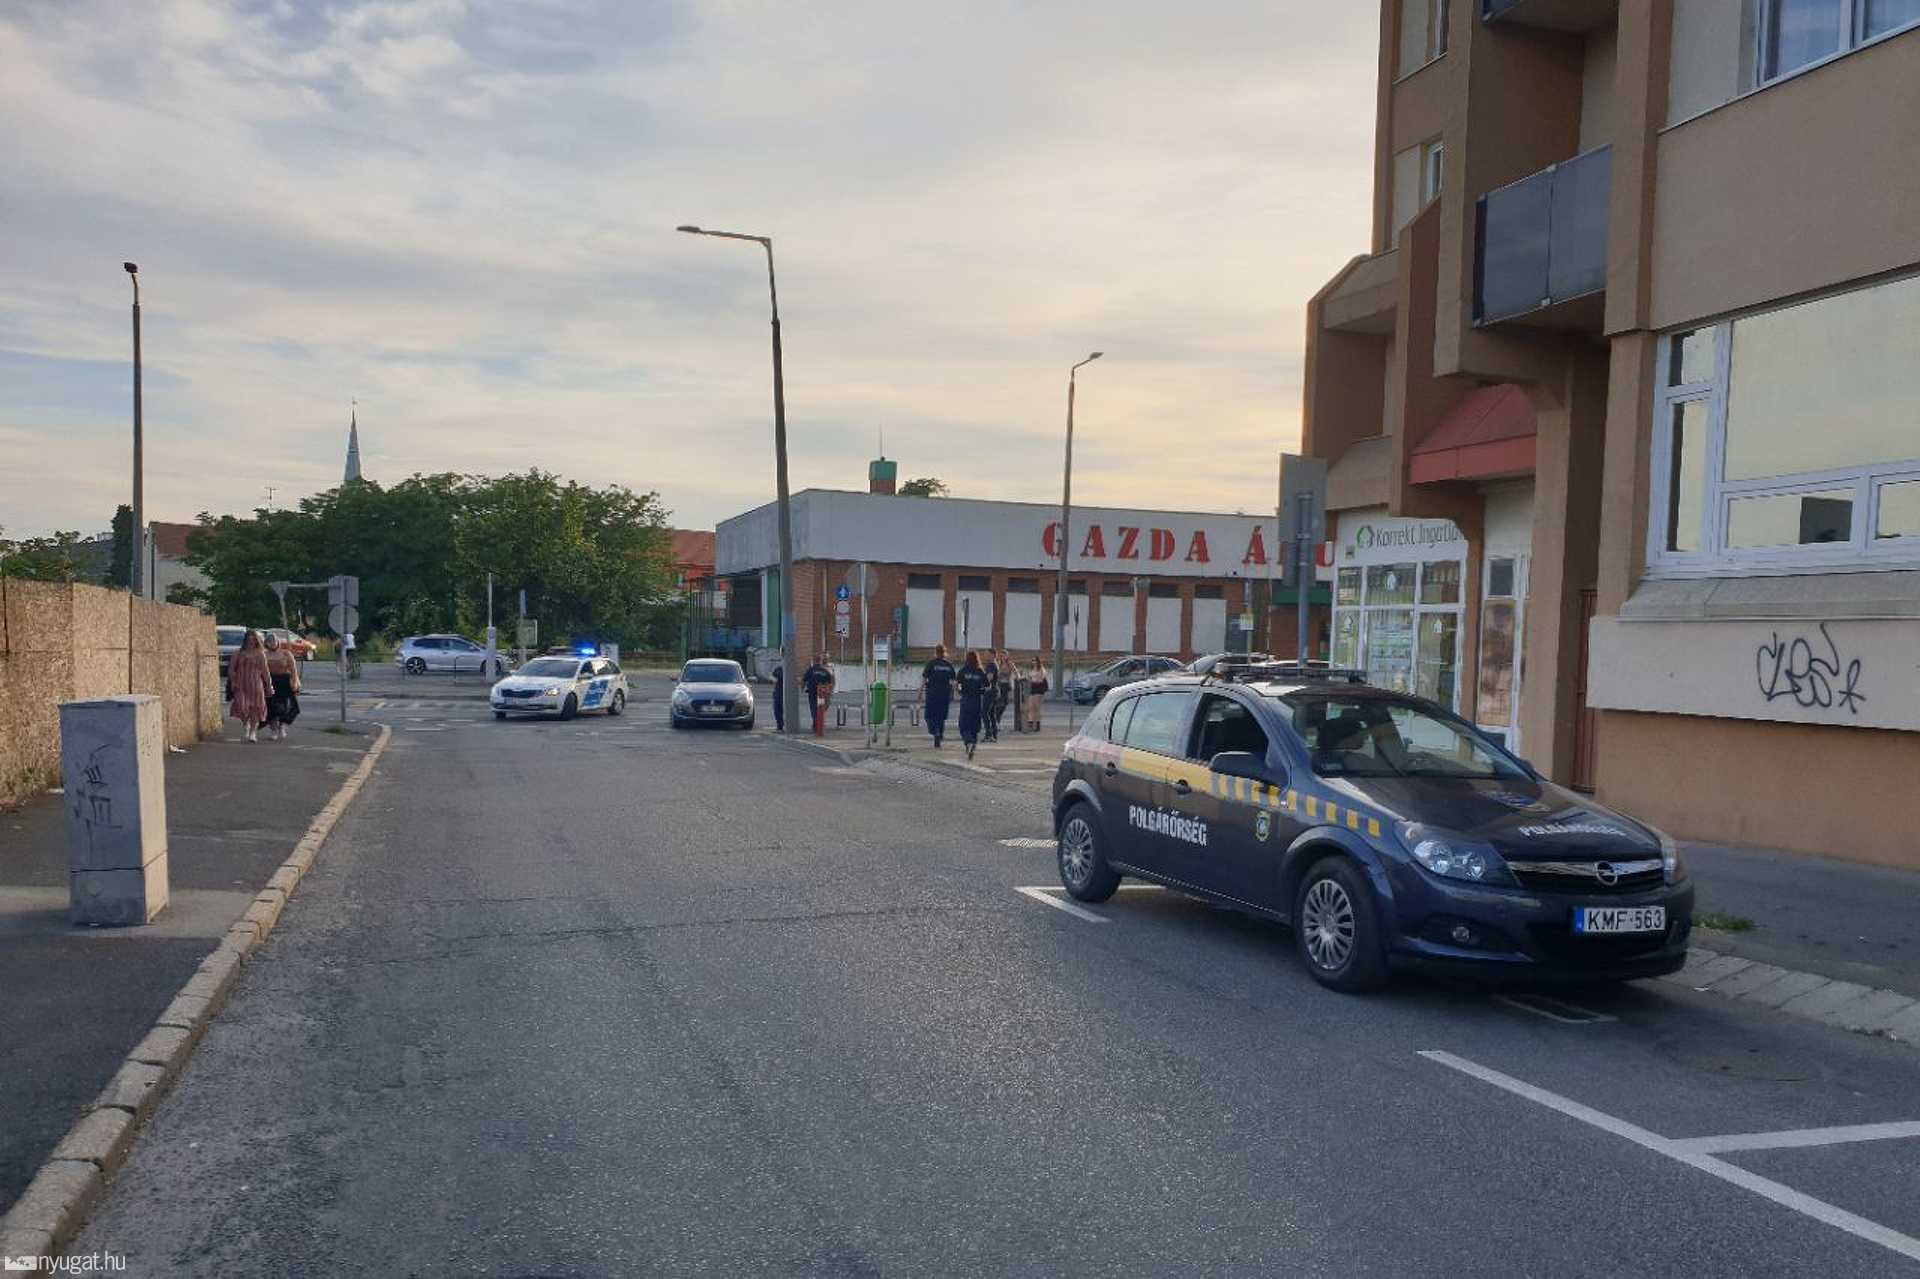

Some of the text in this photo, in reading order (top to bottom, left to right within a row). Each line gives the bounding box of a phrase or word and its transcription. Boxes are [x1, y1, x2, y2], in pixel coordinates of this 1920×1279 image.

[1042, 522, 1335, 567] GAZDA ÁU
[1376, 526, 1416, 547] Korrekt
[1129, 804, 1208, 846] POLGÁRŐRSÉG
